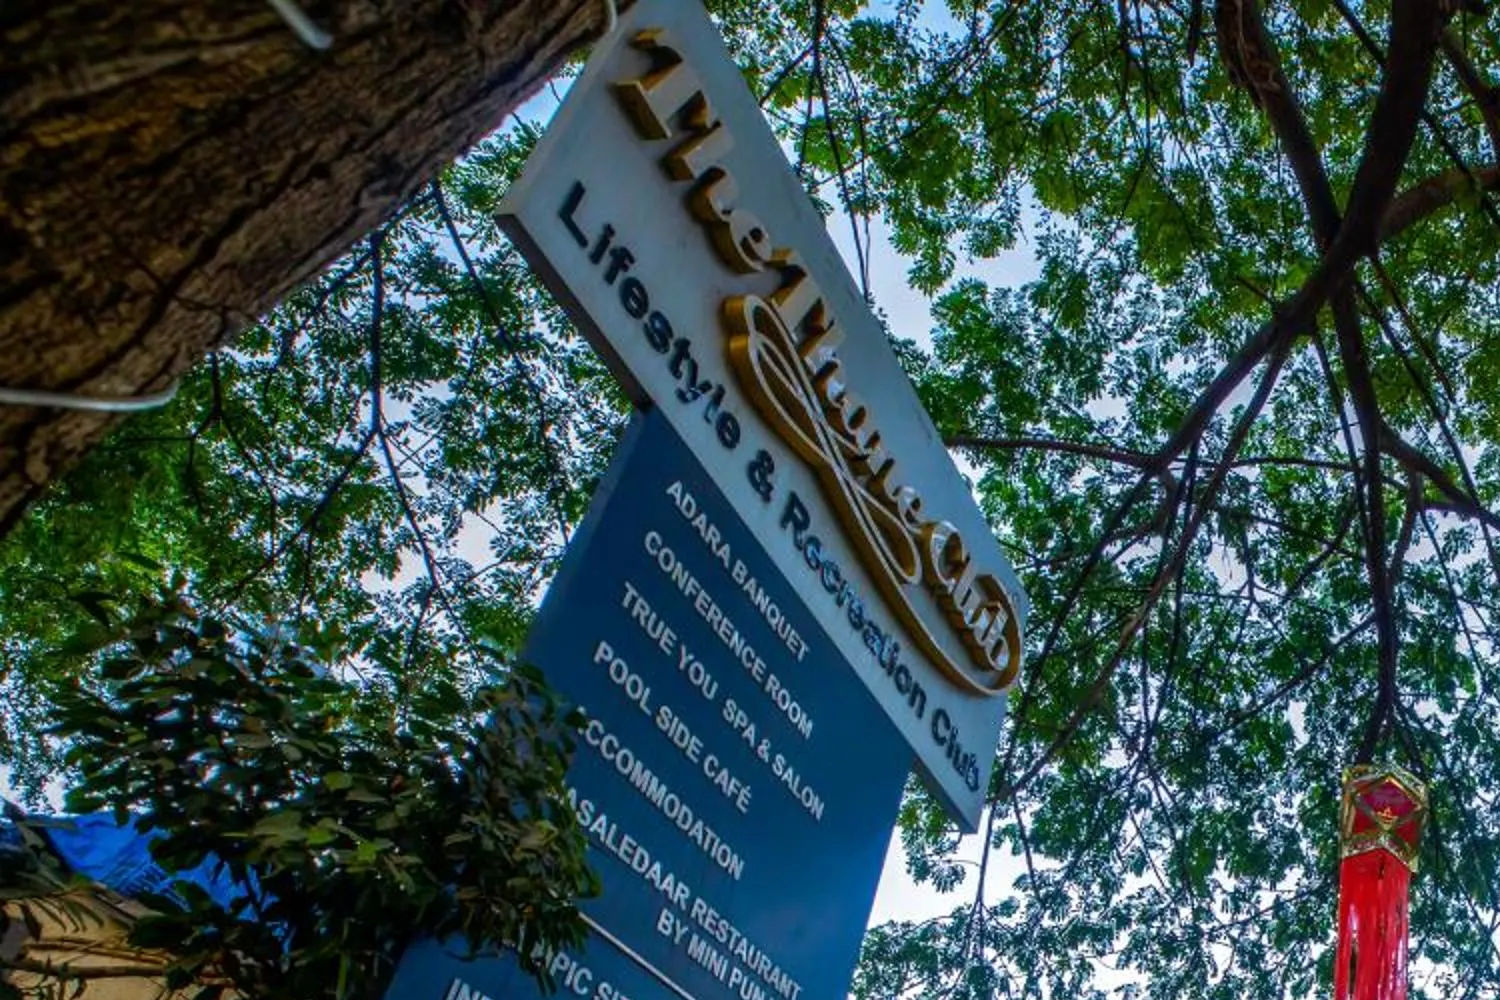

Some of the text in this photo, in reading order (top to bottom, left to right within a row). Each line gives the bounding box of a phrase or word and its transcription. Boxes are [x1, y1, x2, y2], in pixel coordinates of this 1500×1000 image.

[611, 27, 773, 274] The
[557, 179, 980, 793] Lifestyle & Recreation Club
[665, 479, 810, 663] ADARA BANQUET
[593, 640, 752, 814] POOL SIDE CAFÉ
[620, 581, 825, 821] TRUE YOU SPA & SALON
[643, 530, 815, 740] CONFERENCE ROOM
[564, 784, 690, 911] ASALEDAAR
[656, 908, 688, 945] BY
[687, 934, 728, 983] MINI
